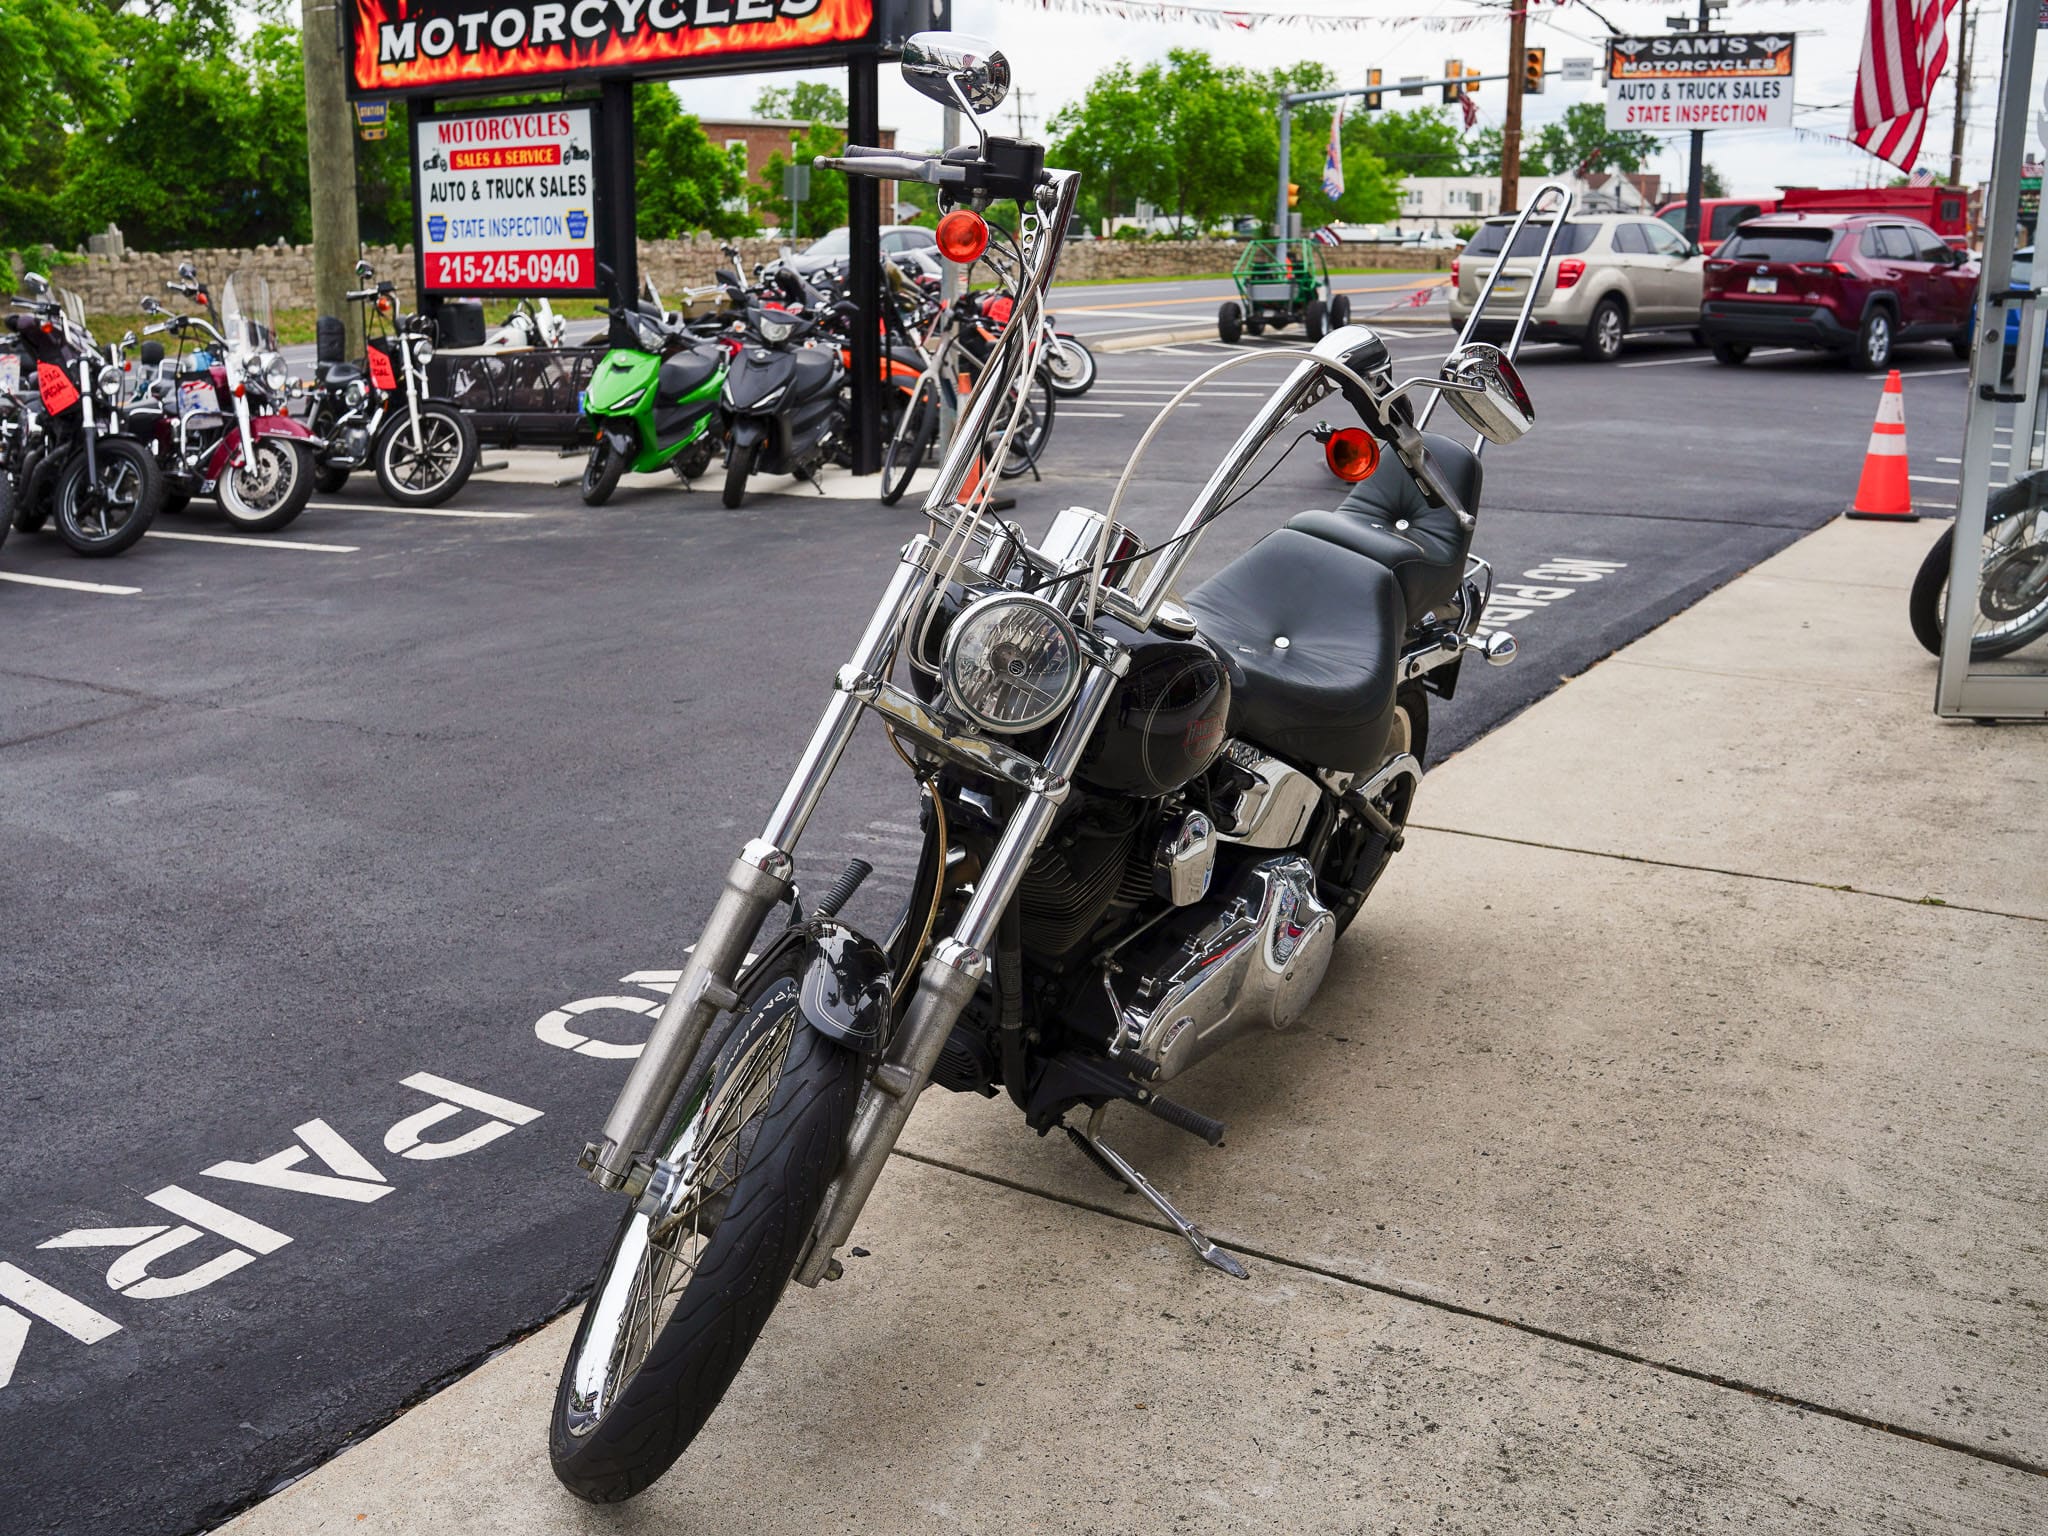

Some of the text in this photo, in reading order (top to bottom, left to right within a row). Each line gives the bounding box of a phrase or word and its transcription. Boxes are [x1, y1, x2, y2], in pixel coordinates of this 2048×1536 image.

[1652, 37, 1748, 55] SAM'S
[1623, 59, 1776, 73] MOTORCYCLES
[1618, 81, 1780, 100] AUTO & TRUCK SALES
[1626, 104, 1767, 122] STATE INSPECTION
[438, 113, 569, 144] MOTORCYCLES
[456, 148, 554, 168] SALES & SERVICE
[430, 174, 587, 202] AUTO & TRUCK SALES
[452, 218, 485, 238] STATE
[489, 216, 562, 237] INSPECTION
[439, 253, 579, 283] 215-245-0940
[1523, 557, 1628, 582] NO
